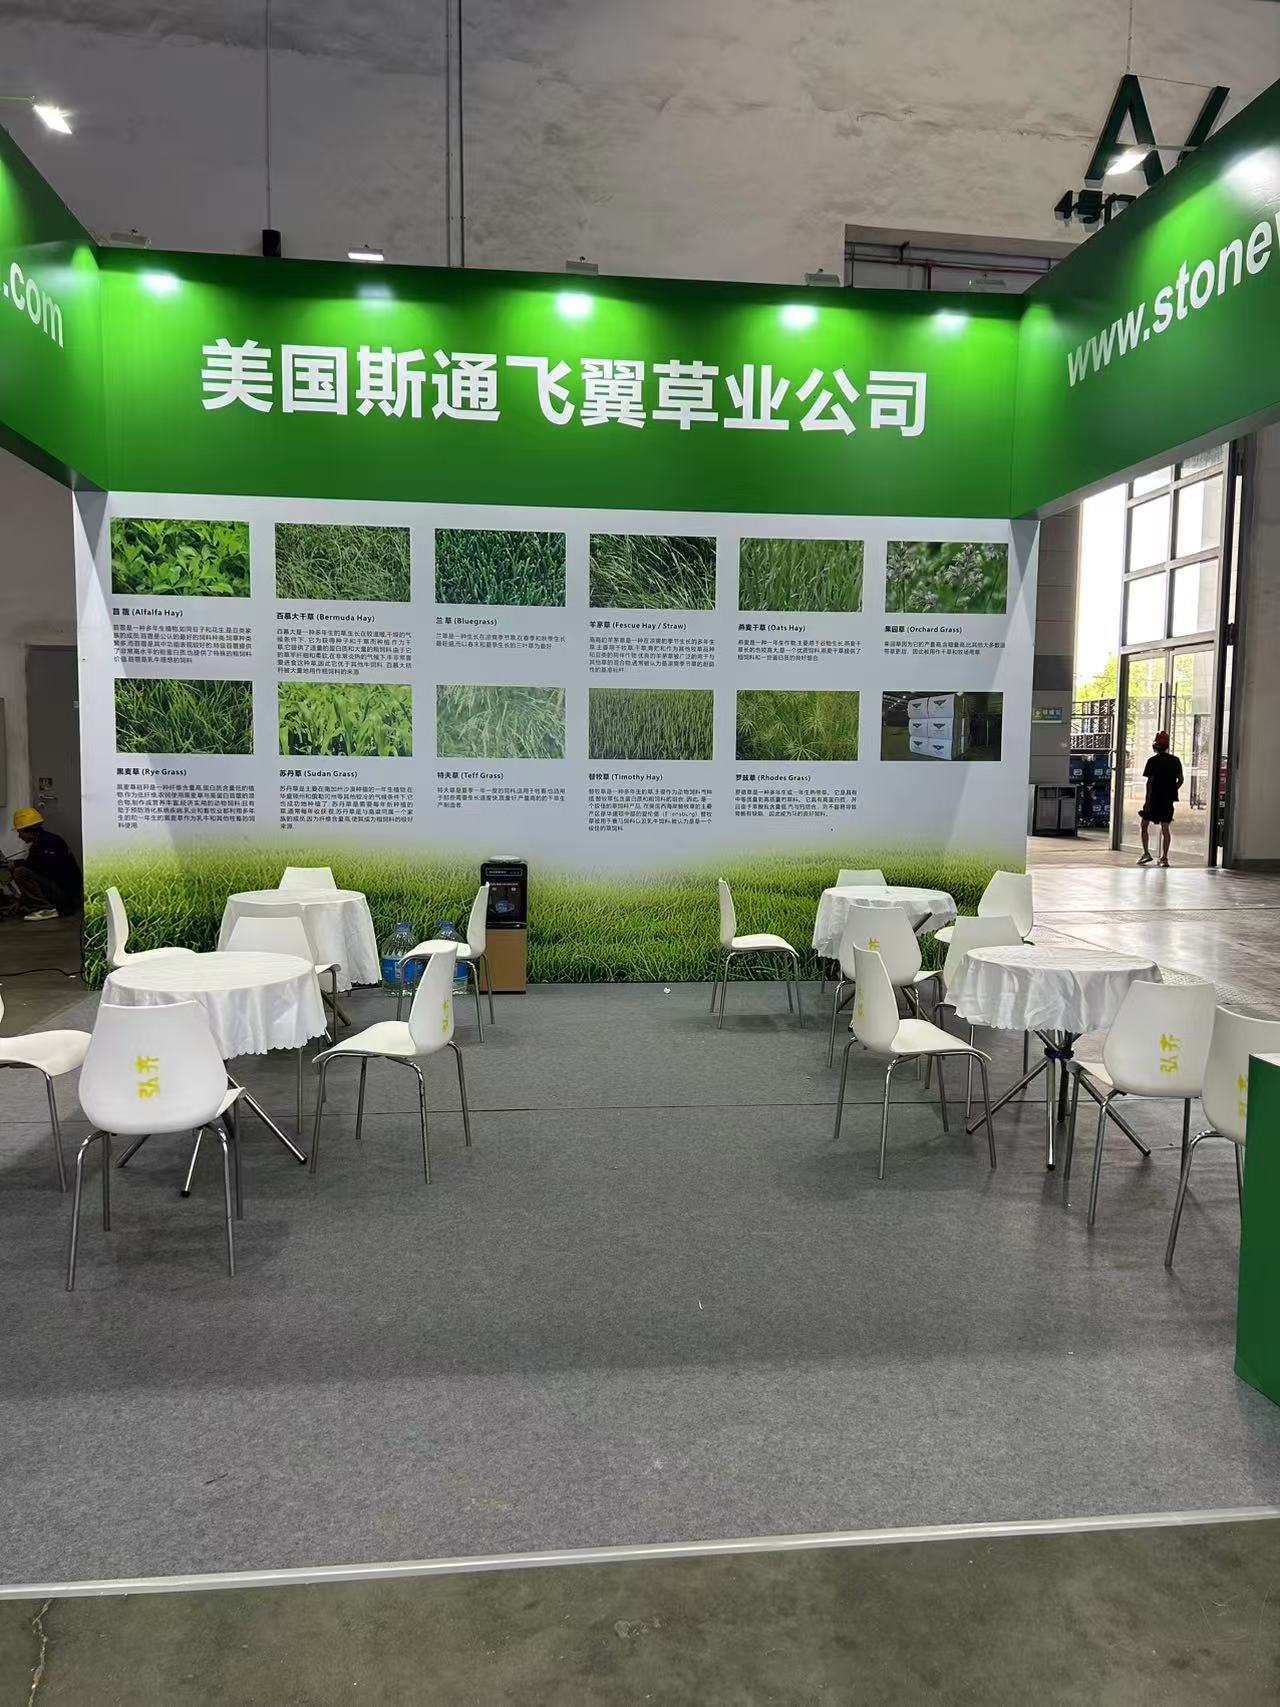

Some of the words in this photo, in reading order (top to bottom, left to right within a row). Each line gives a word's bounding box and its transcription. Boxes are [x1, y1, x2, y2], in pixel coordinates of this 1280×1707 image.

[1067, 210, 1280, 388] www.stone
[201, 338, 927, 437] 美国斯通飞翼草业公司
[132, 609, 162, 617] (Alfalfa
[164, 610, 183, 618] Hay)
[317, 614, 354, 622] (Bermuda
[357, 615, 375, 623] Hay)
[454, 618, 497, 626] (Bluegrass)
[304, 770, 331, 778] (Sudan
